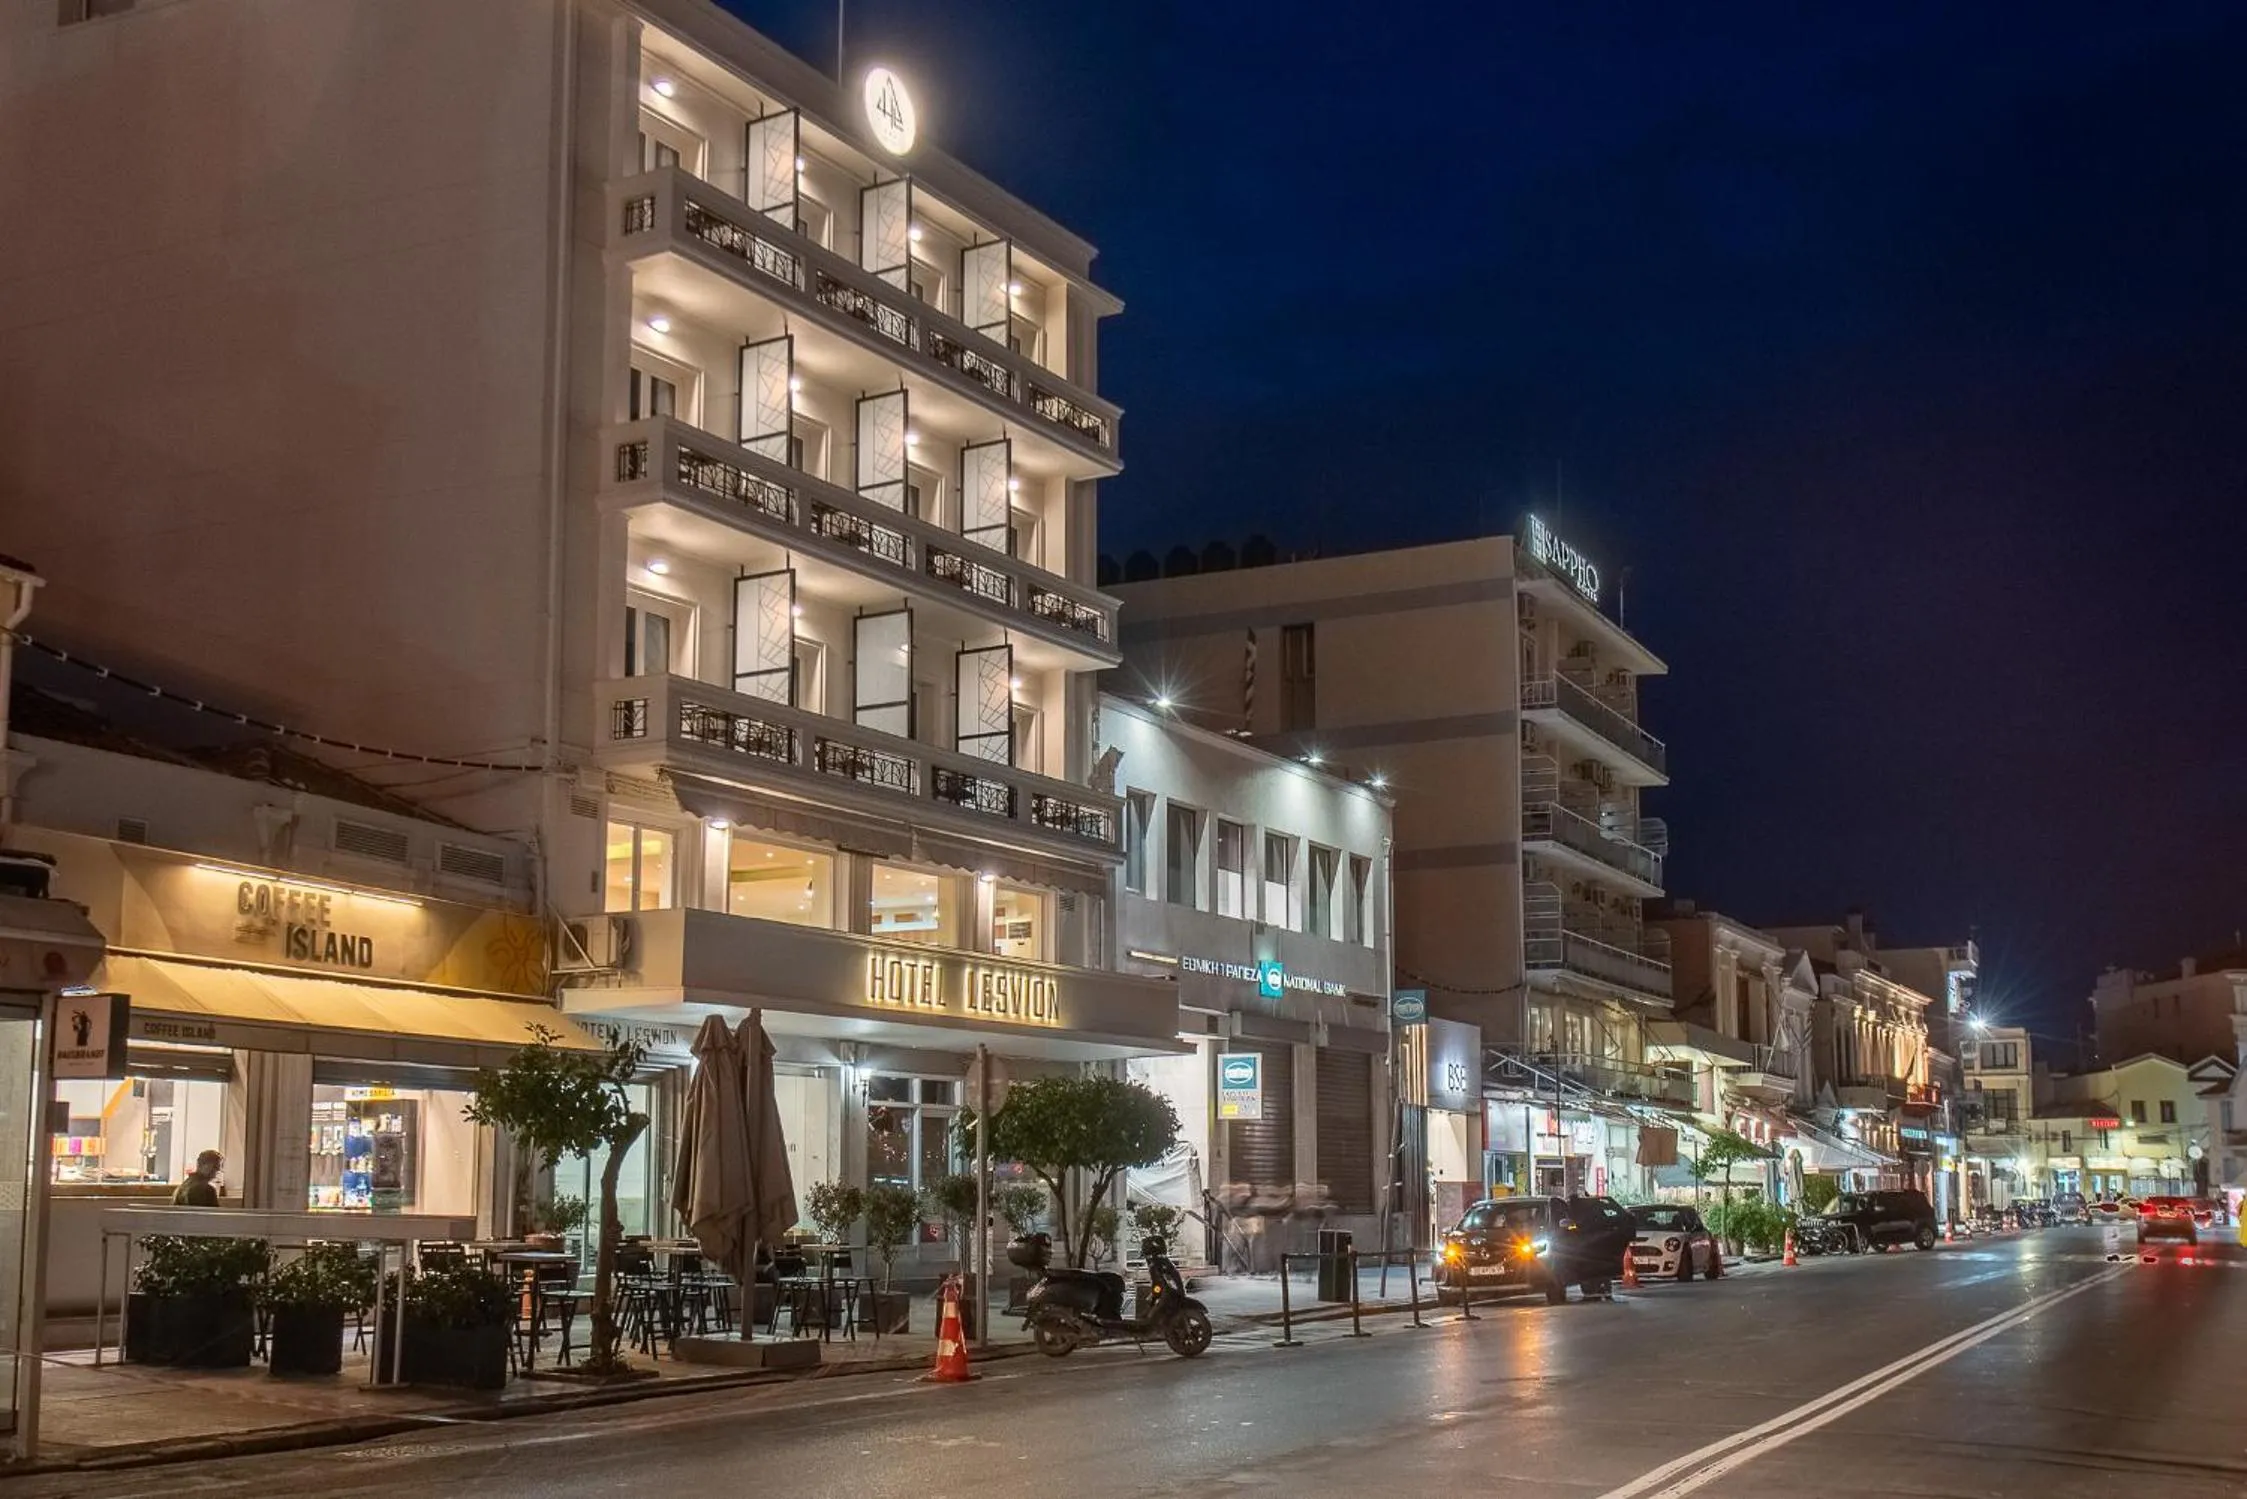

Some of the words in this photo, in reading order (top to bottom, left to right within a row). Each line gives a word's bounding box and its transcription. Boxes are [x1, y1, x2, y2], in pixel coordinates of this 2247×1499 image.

[1545, 529, 1599, 593] SAPPHO
[238, 881, 332, 928] COFFEE
[286, 923, 373, 968] ISLAND
[868, 954, 946, 1008] HOTEL
[966, 968, 1059, 1021] LESVION
[1220, 963, 1262, 983] ΤΡΑΠΕΖΑ
[1283, 973, 1322, 994] NATIONAL
[144, 1021, 179, 1037] COFFEE
